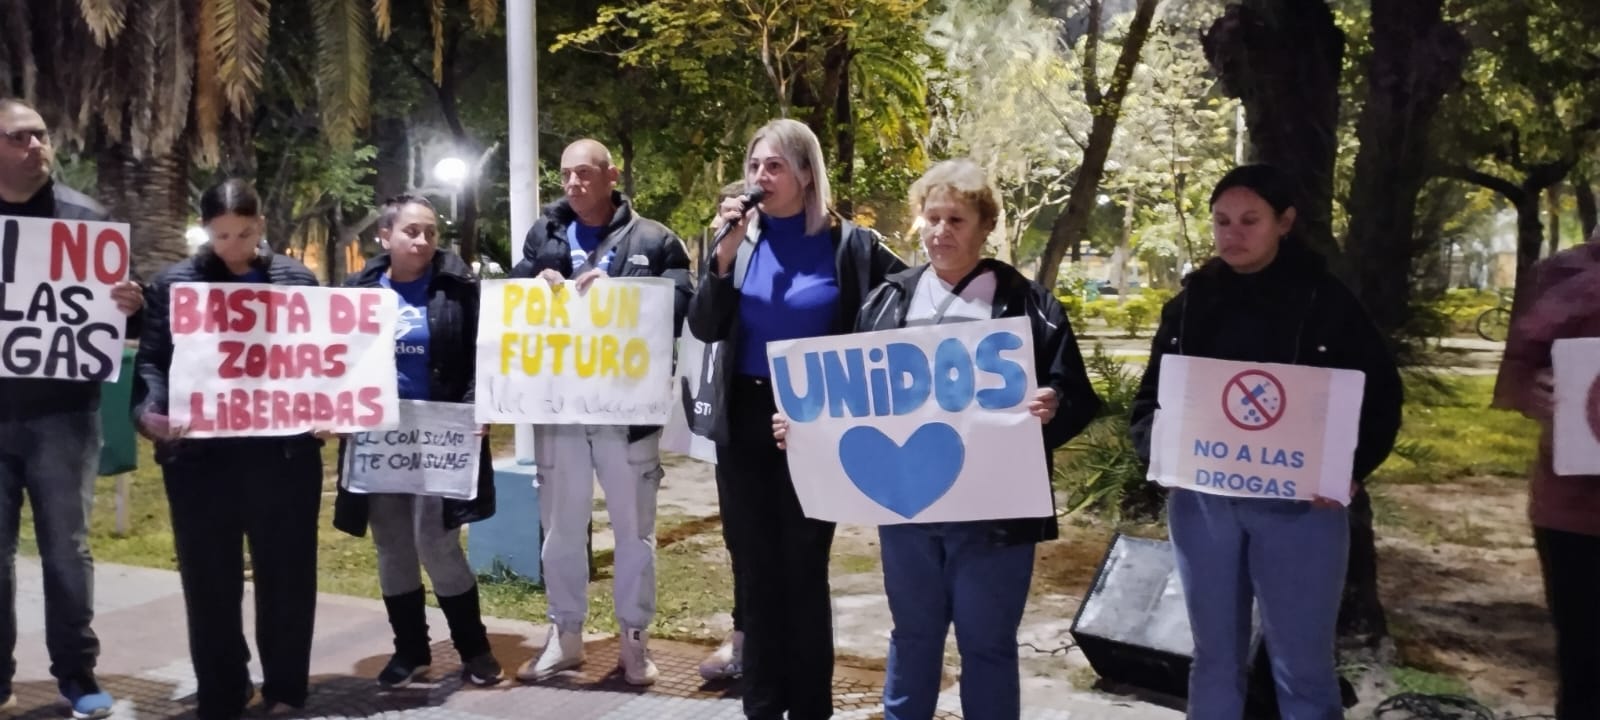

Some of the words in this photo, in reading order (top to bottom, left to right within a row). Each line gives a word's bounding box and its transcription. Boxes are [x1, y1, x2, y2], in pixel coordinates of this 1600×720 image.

[49, 221, 128, 285] NO
[0, 282, 94, 325] LAS
[172, 287, 311, 335] BASTA
[329, 292, 381, 335] DE
[502, 283, 570, 328] POR
[588, 286, 642, 329] UN
[2, 322, 119, 381] GAS
[500, 332, 650, 379] FUTURO
[355, 431, 380, 446] EL
[1193, 438, 1229, 459] NO
[1235, 444, 1252, 463] A
[1260, 446, 1305, 469] LAS
[357, 452, 385, 473] TE
[387, 451, 471, 471] CONSUME
[1195, 468, 1297, 498] DROGAS
